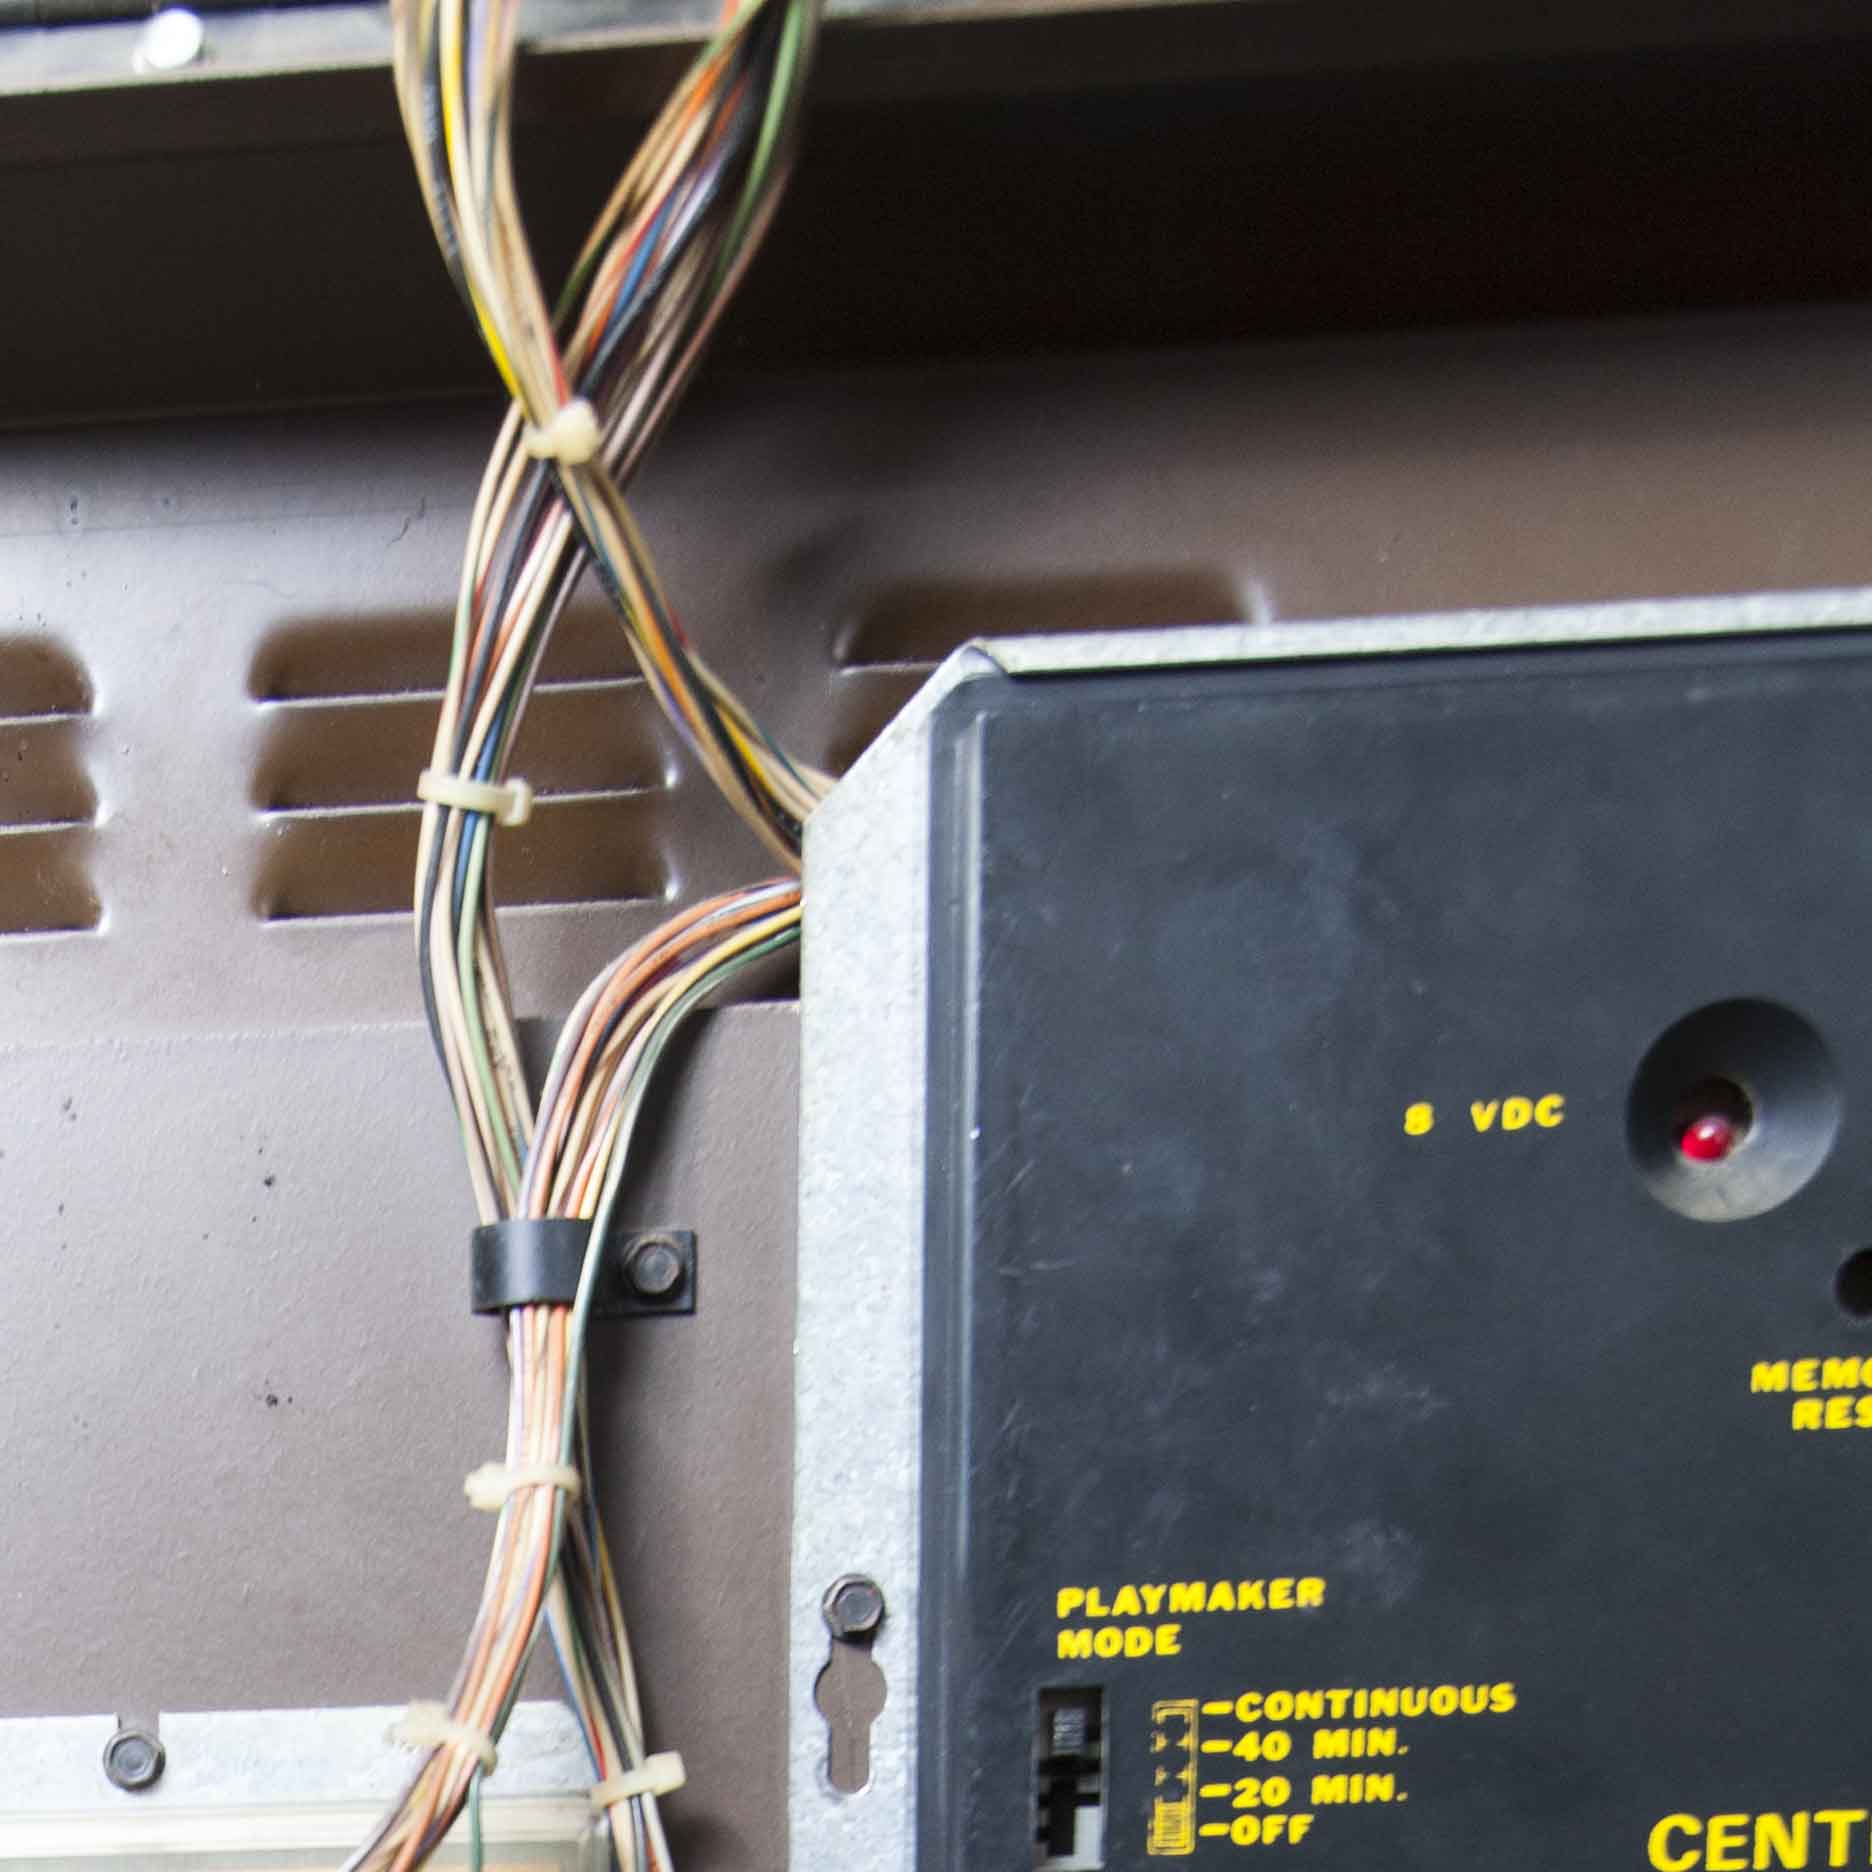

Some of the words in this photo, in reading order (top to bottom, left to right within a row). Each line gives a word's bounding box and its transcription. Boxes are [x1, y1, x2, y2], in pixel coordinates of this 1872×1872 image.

[1404, 1101, 1434, 1136] 8
[1470, 1093, 1565, 1133] VDC
[1056, 1577, 1327, 1619] PLAYMAKER
[1056, 1623, 1182, 1660] MODE
[1235, 1682, 1517, 1724] CONTINUOUS
[1312, 1727, 1409, 1760] MIN.
[1310, 1774, 1409, 1805] MIN.
[1230, 1814, 1315, 1847] OFF
[1647, 1809, 1872, 1872] CENT
